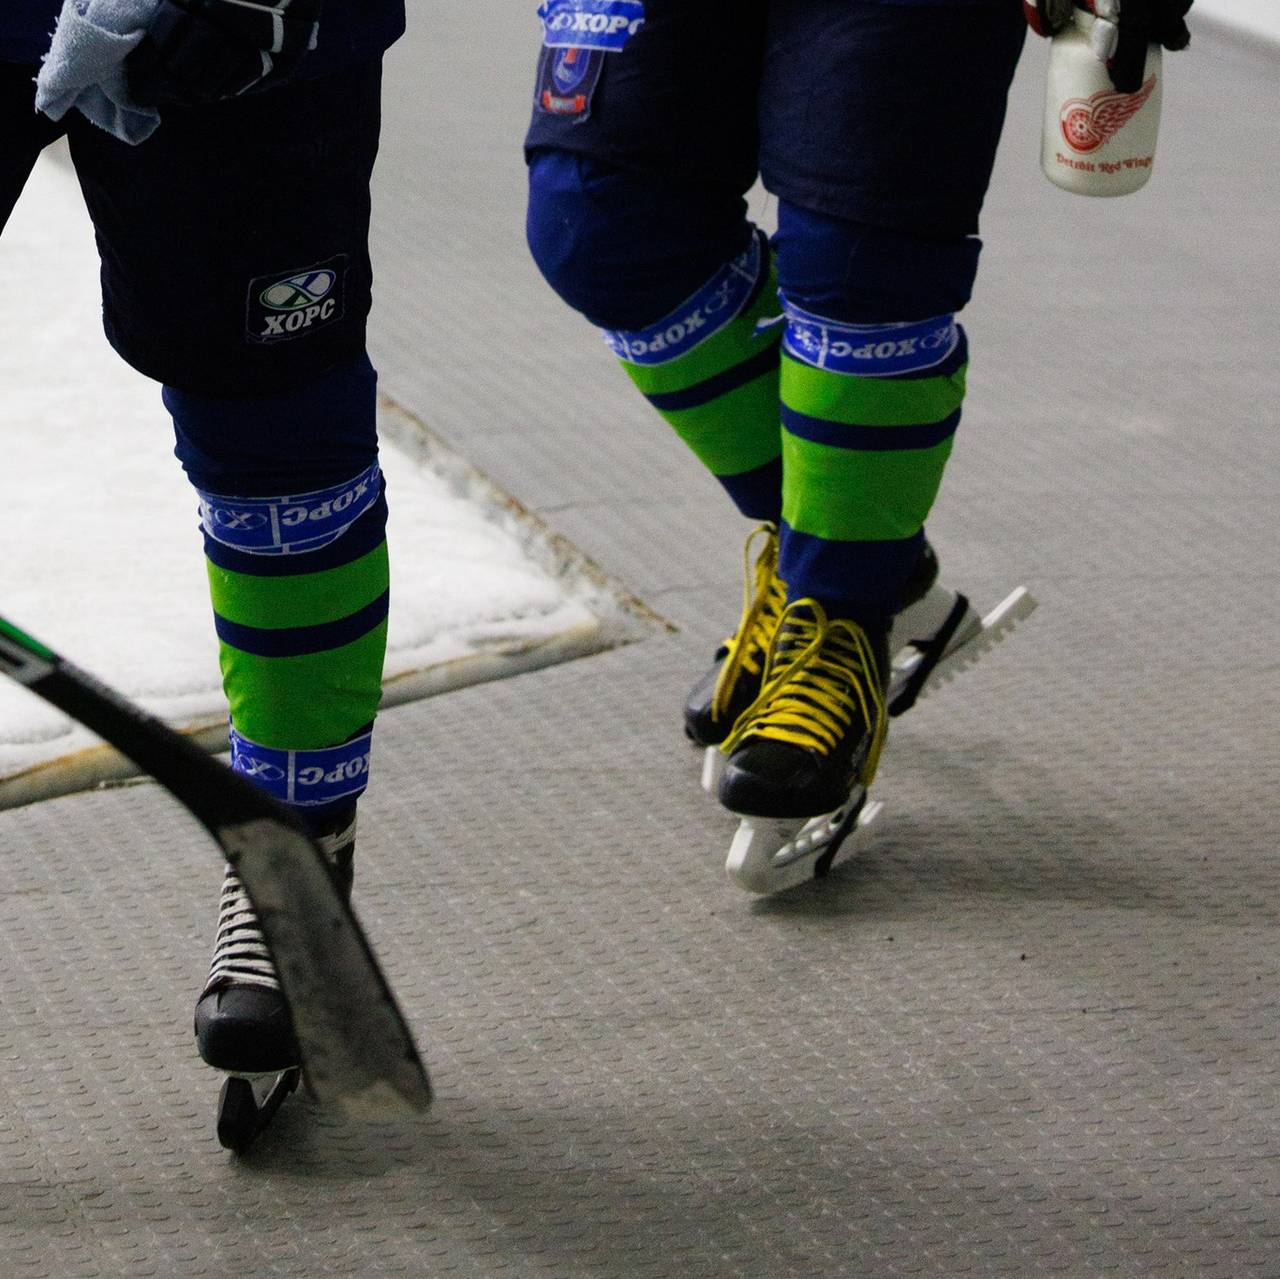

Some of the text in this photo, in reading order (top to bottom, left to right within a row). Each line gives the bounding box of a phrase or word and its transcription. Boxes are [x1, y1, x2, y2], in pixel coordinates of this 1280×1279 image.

[261, 298, 336, 336] ХОРС
[631, 309, 707, 356] ХОРС
[828, 337, 919, 360] ХОРС
[281, 477, 369, 527] ХОРС
